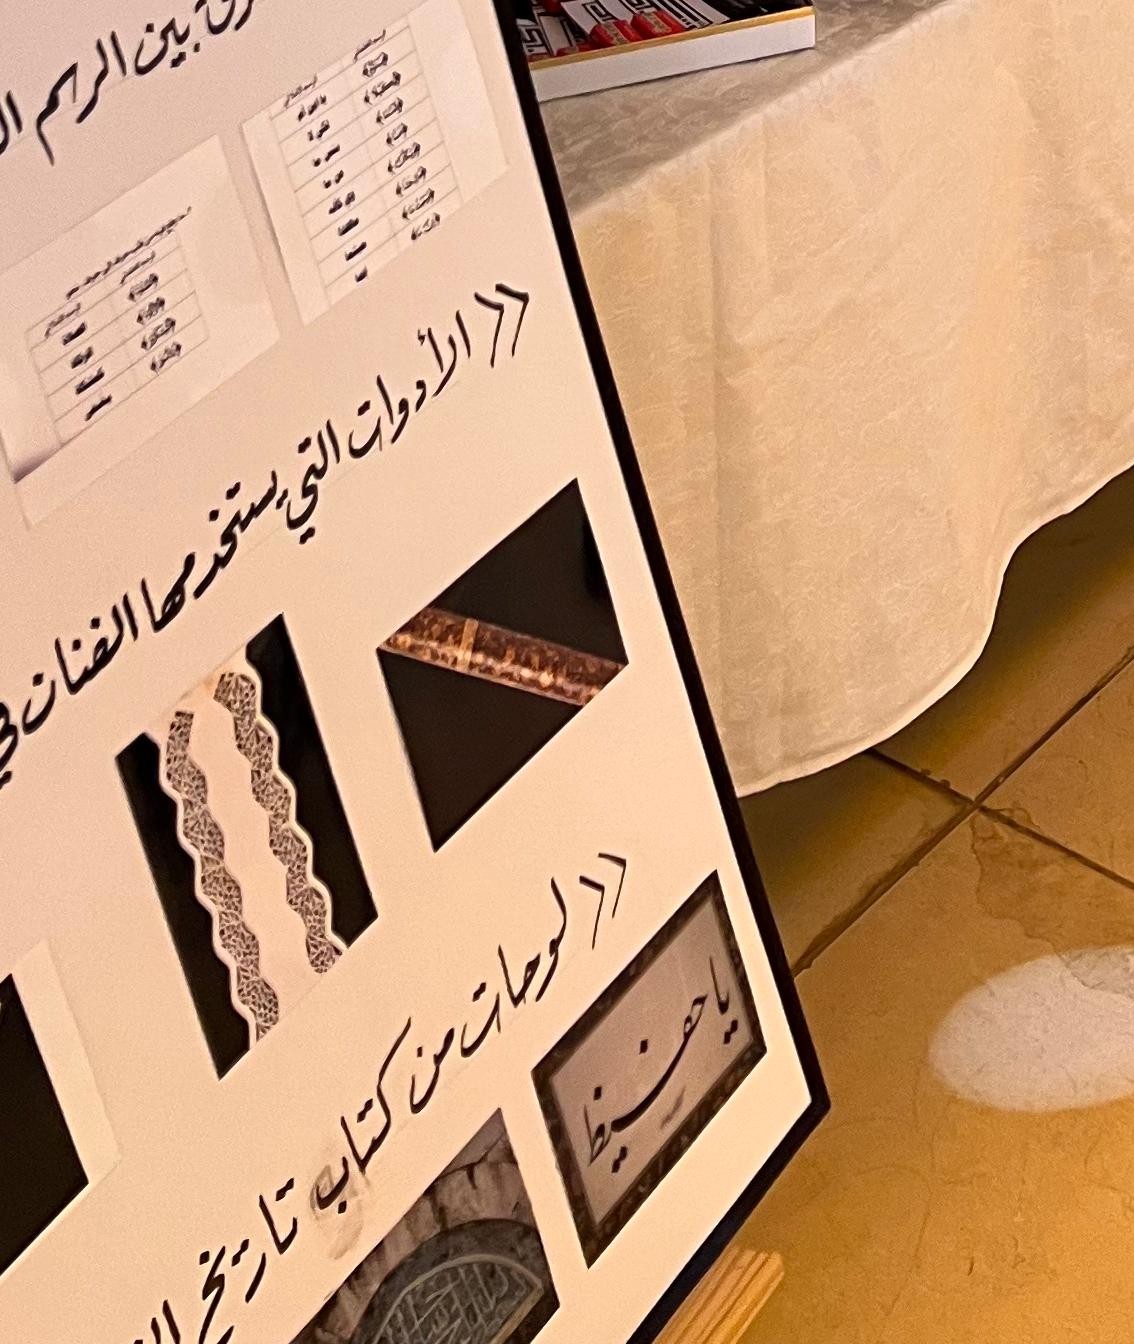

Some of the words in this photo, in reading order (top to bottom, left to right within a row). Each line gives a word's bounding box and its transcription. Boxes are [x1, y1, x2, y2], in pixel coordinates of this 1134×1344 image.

[36, 30, 128, 167] الرسم
[135, 16, 203, 77] بين
[348, 310, 472, 459] الأدوات
[140, 468, 291, 635] يستخدمها
[284, 419, 342, 546] التي
[21, 593, 139, 736] الفنان
[459, 876, 568, 1059] لوحات
[709, 954, 739, 1046] يا
[313, 1015, 412, 1215] كتاب
[409, 1027, 456, 1115] من
[583, 993, 708, 1174] حفيظ
[198, 1176, 299, 1344] تاريخ
